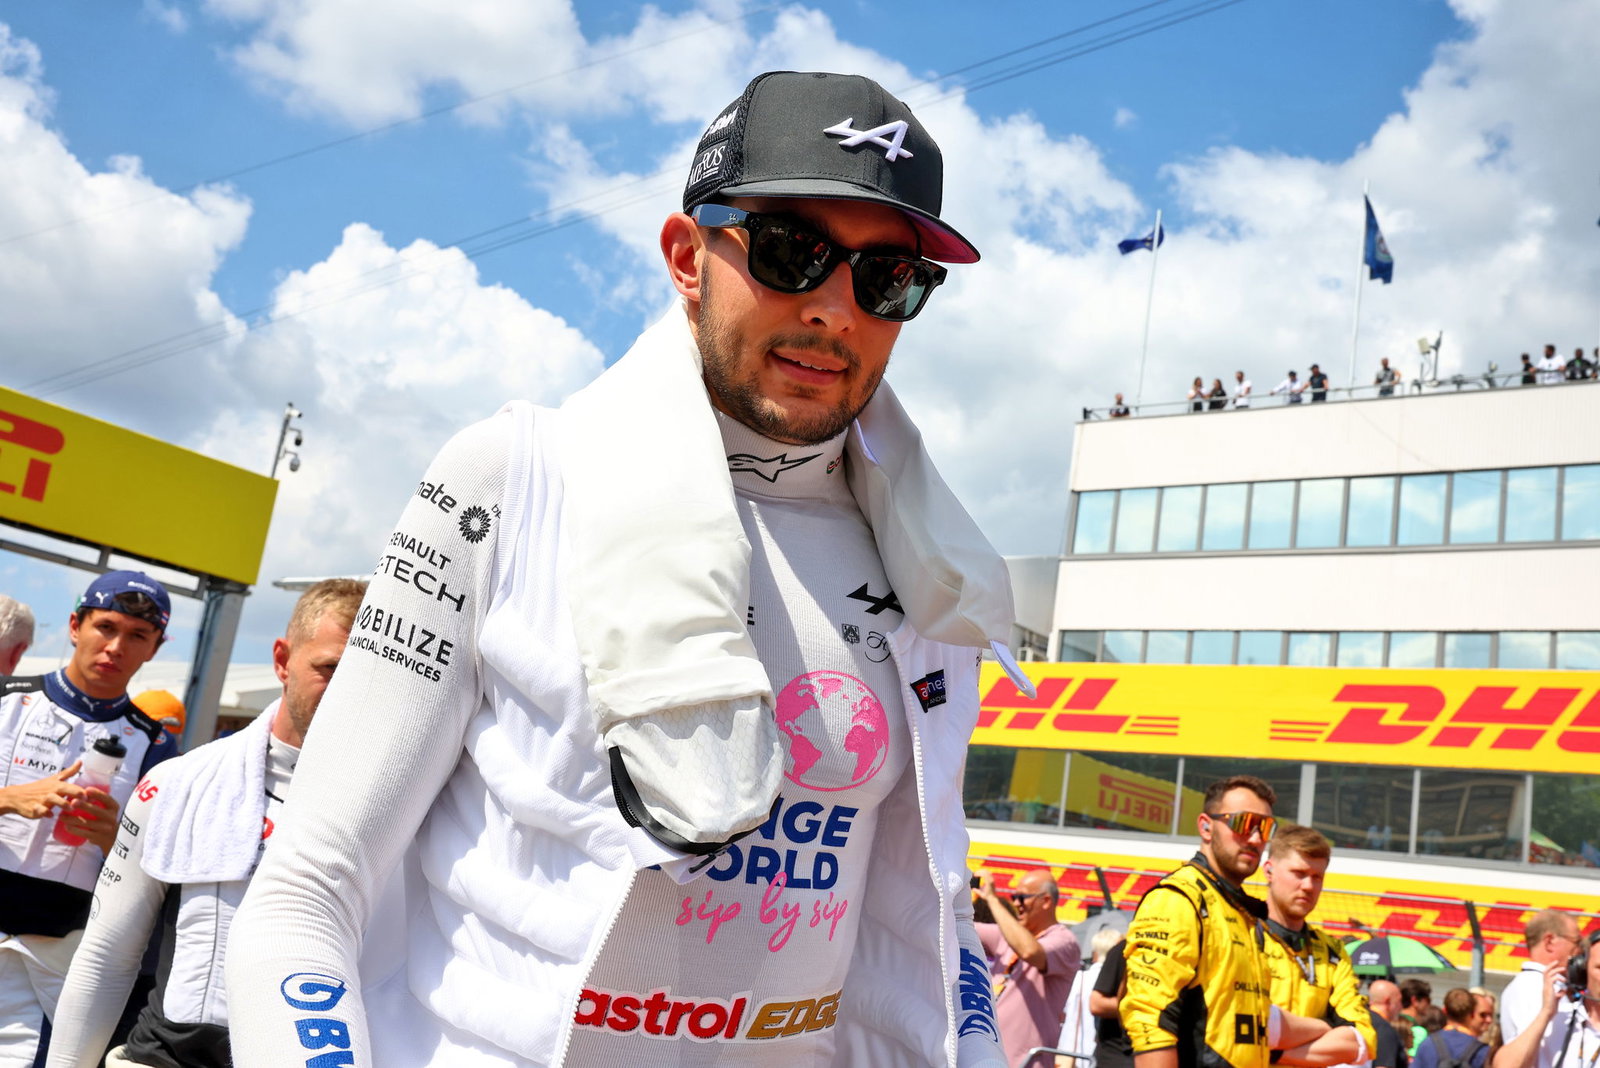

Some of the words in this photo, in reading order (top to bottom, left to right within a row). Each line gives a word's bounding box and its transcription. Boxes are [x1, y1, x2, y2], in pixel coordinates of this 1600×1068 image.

[381, 645, 442, 683] SERVICES
[704, 843, 839, 890] ORLD
[674, 890, 742, 944] sip
[759, 872, 802, 953] by
[809, 892, 848, 942] sip
[573, 988, 748, 1039] astrol
[745, 989, 843, 1040] EDGE
